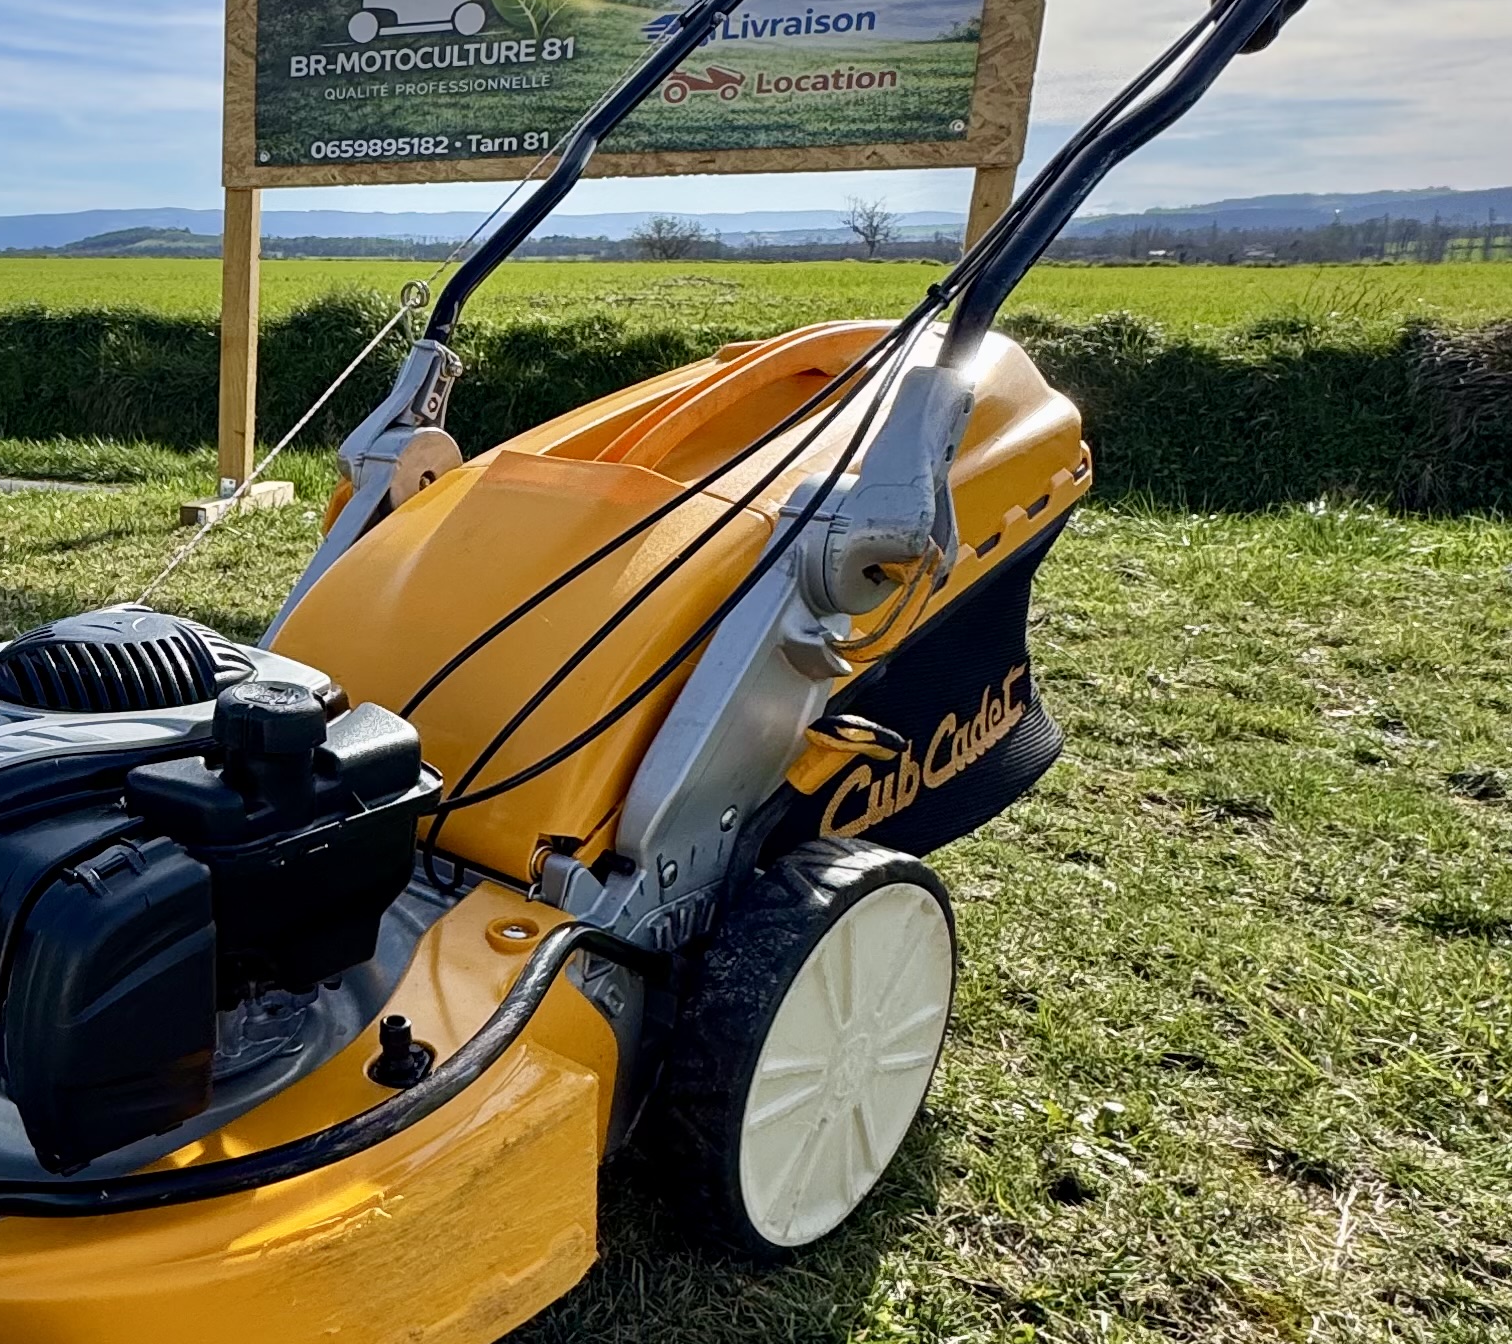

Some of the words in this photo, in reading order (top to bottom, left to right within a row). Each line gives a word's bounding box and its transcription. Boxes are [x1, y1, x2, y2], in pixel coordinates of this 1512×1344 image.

[721, 8, 877, 40] Livraison
[290, 39, 537, 77] BR-MOTOCULTURE
[541, 36, 575, 60] 81
[324, 82, 389, 101] QUALITÉ
[395, 75, 551, 96] PROFESSIONNELLE
[756, 66, 897, 94] Location
[310, 135, 450, 159] 0659895182
[467, 134, 518, 153] Tarn
[522, 131, 550, 151] 81
[819, 739, 921, 839] Cub
[922, 664, 1026, 790] Cadet
